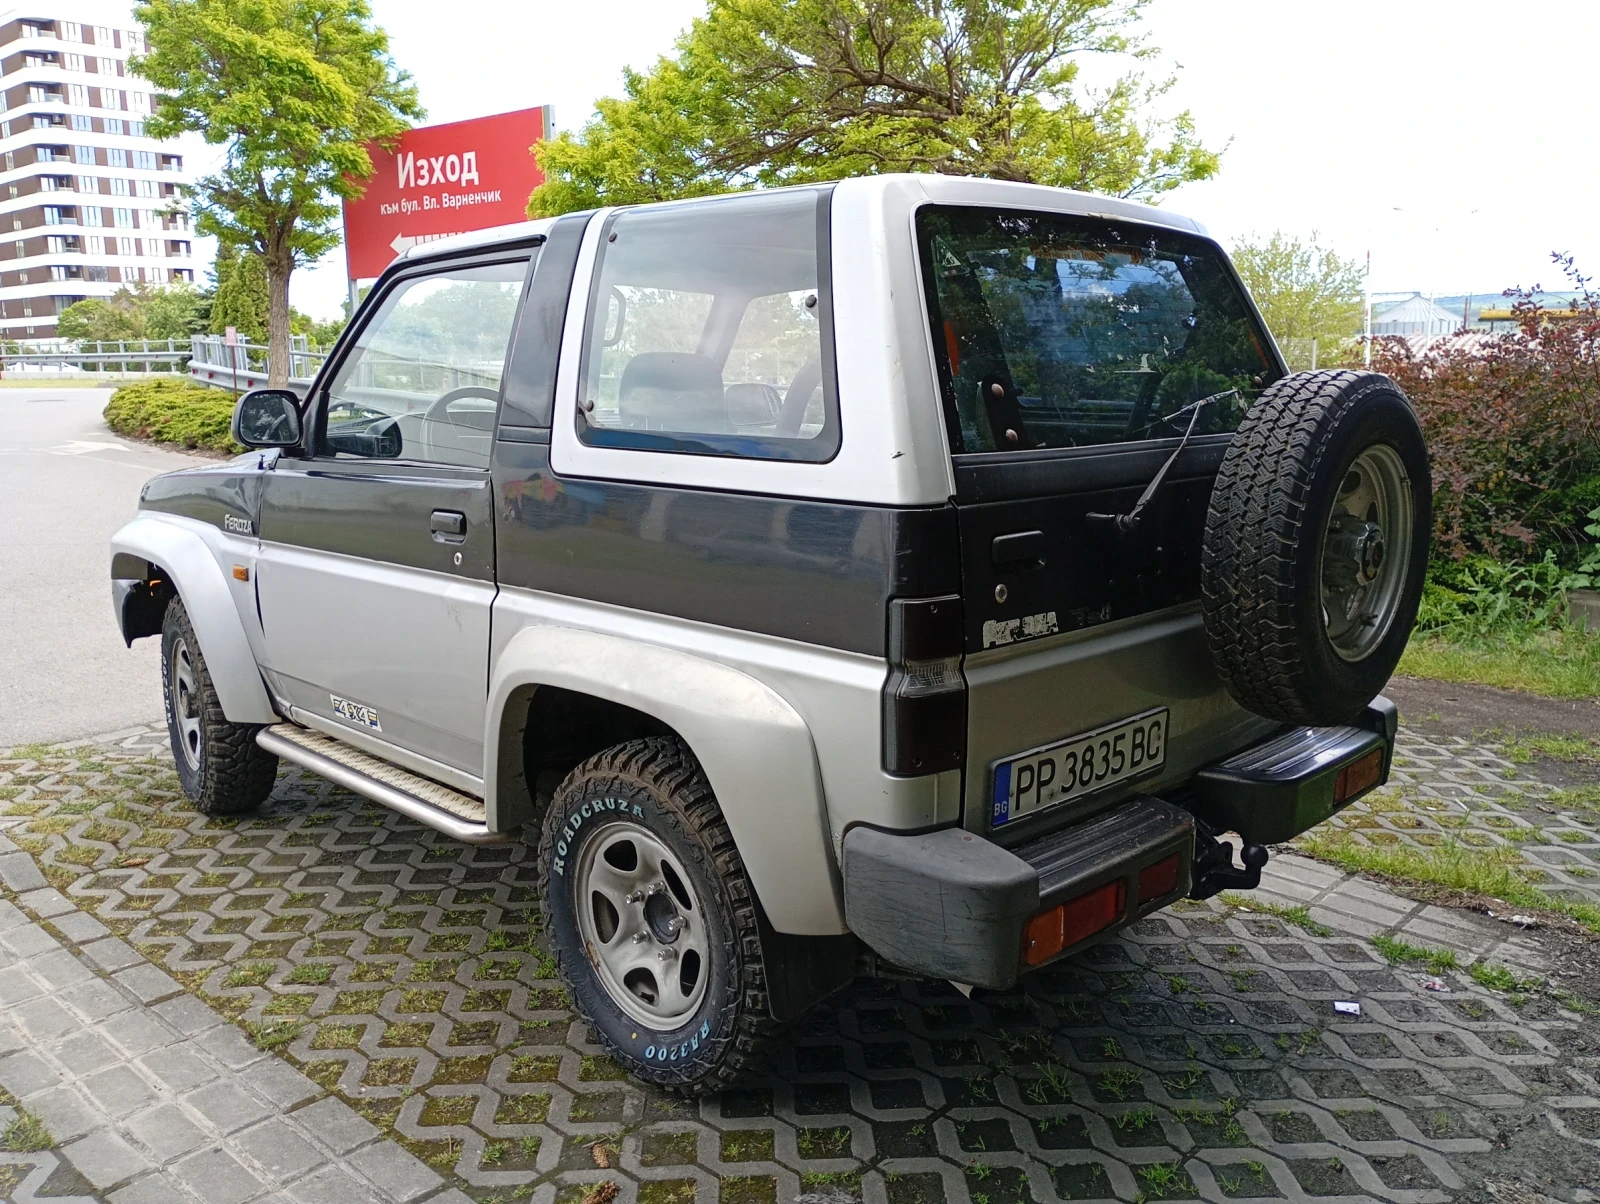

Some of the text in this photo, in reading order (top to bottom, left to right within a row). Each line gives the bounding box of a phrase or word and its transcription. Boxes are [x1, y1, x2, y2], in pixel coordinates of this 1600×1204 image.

[397, 151, 479, 189] Изход
[380, 190, 502, 216] към бул. Вл. Варненчик
[1060, 732, 1126, 794] 3835
[994, 800, 1008, 817] BG
[553, 797, 644, 876] ROADCRUZA
[645, 1018, 711, 1061] RA3200
